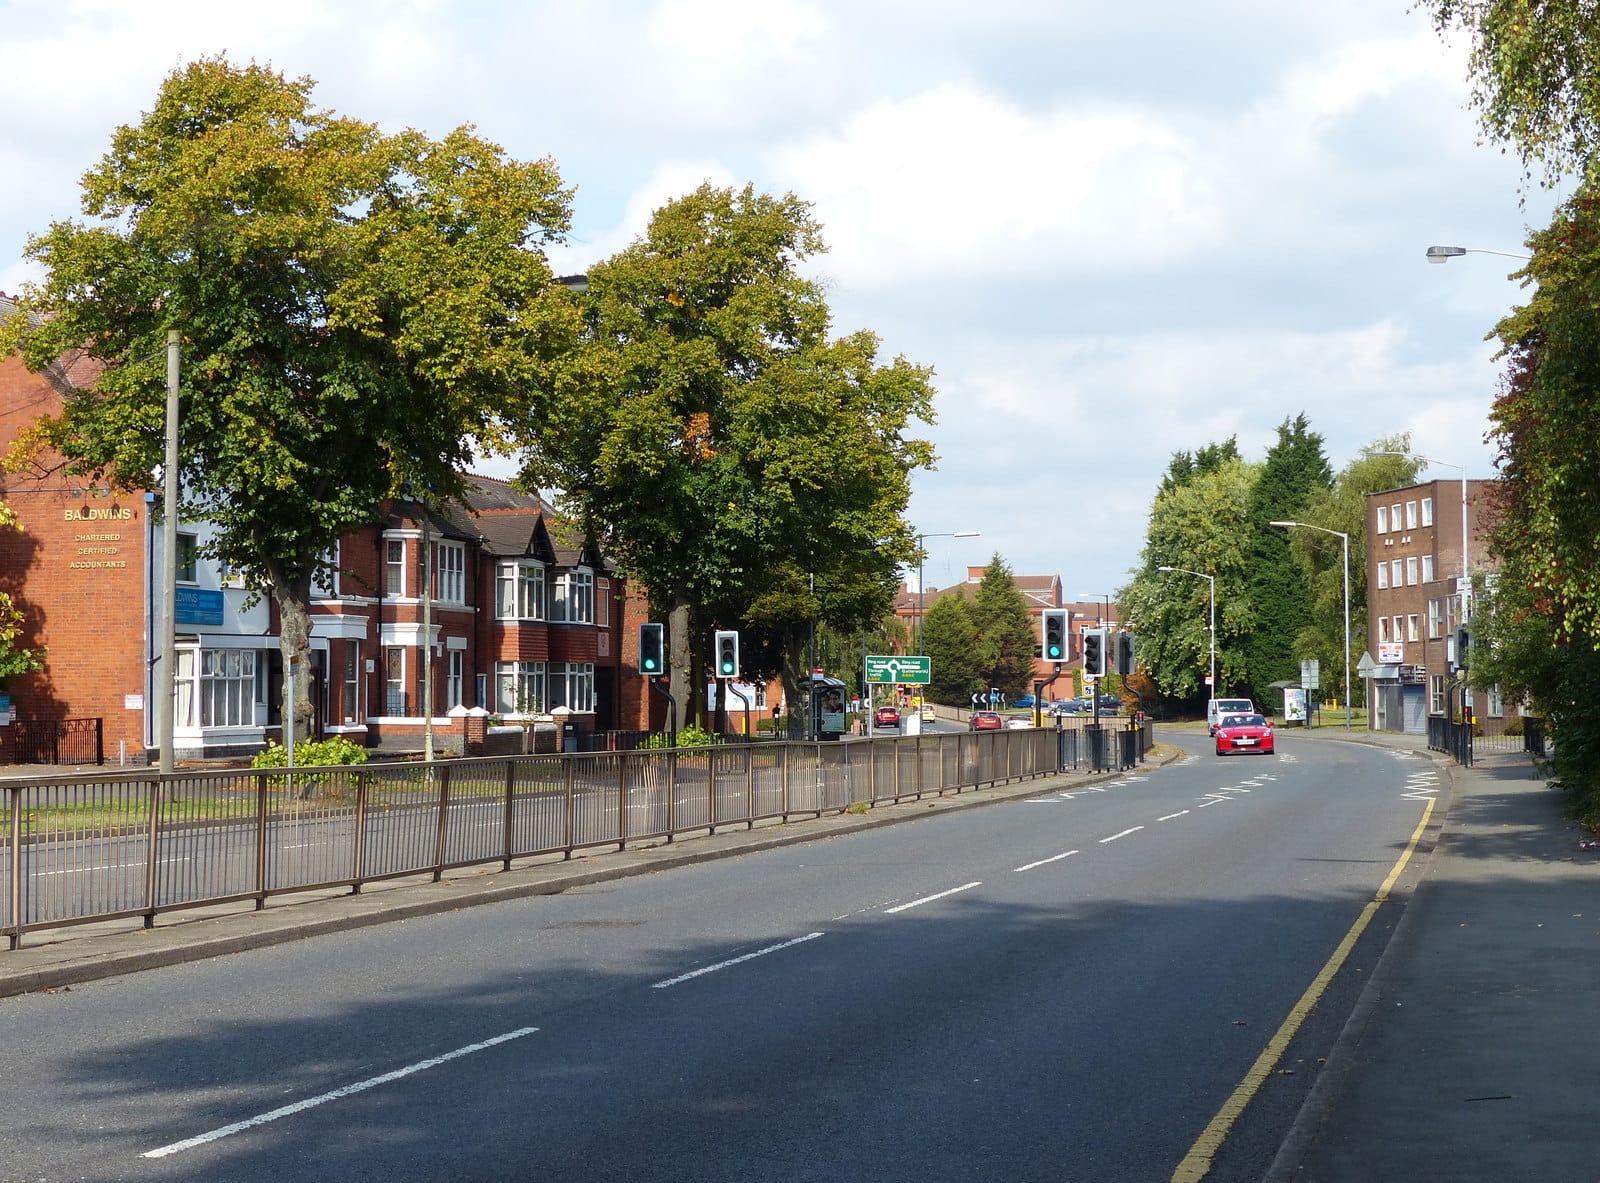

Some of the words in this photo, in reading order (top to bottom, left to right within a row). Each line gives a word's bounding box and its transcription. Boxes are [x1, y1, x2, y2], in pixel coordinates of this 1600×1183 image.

[64, 508, 131, 521] BALDWINS
[75, 534, 121, 542] CHARTERED
[70, 560, 126, 569] ACCOUNTANTS
